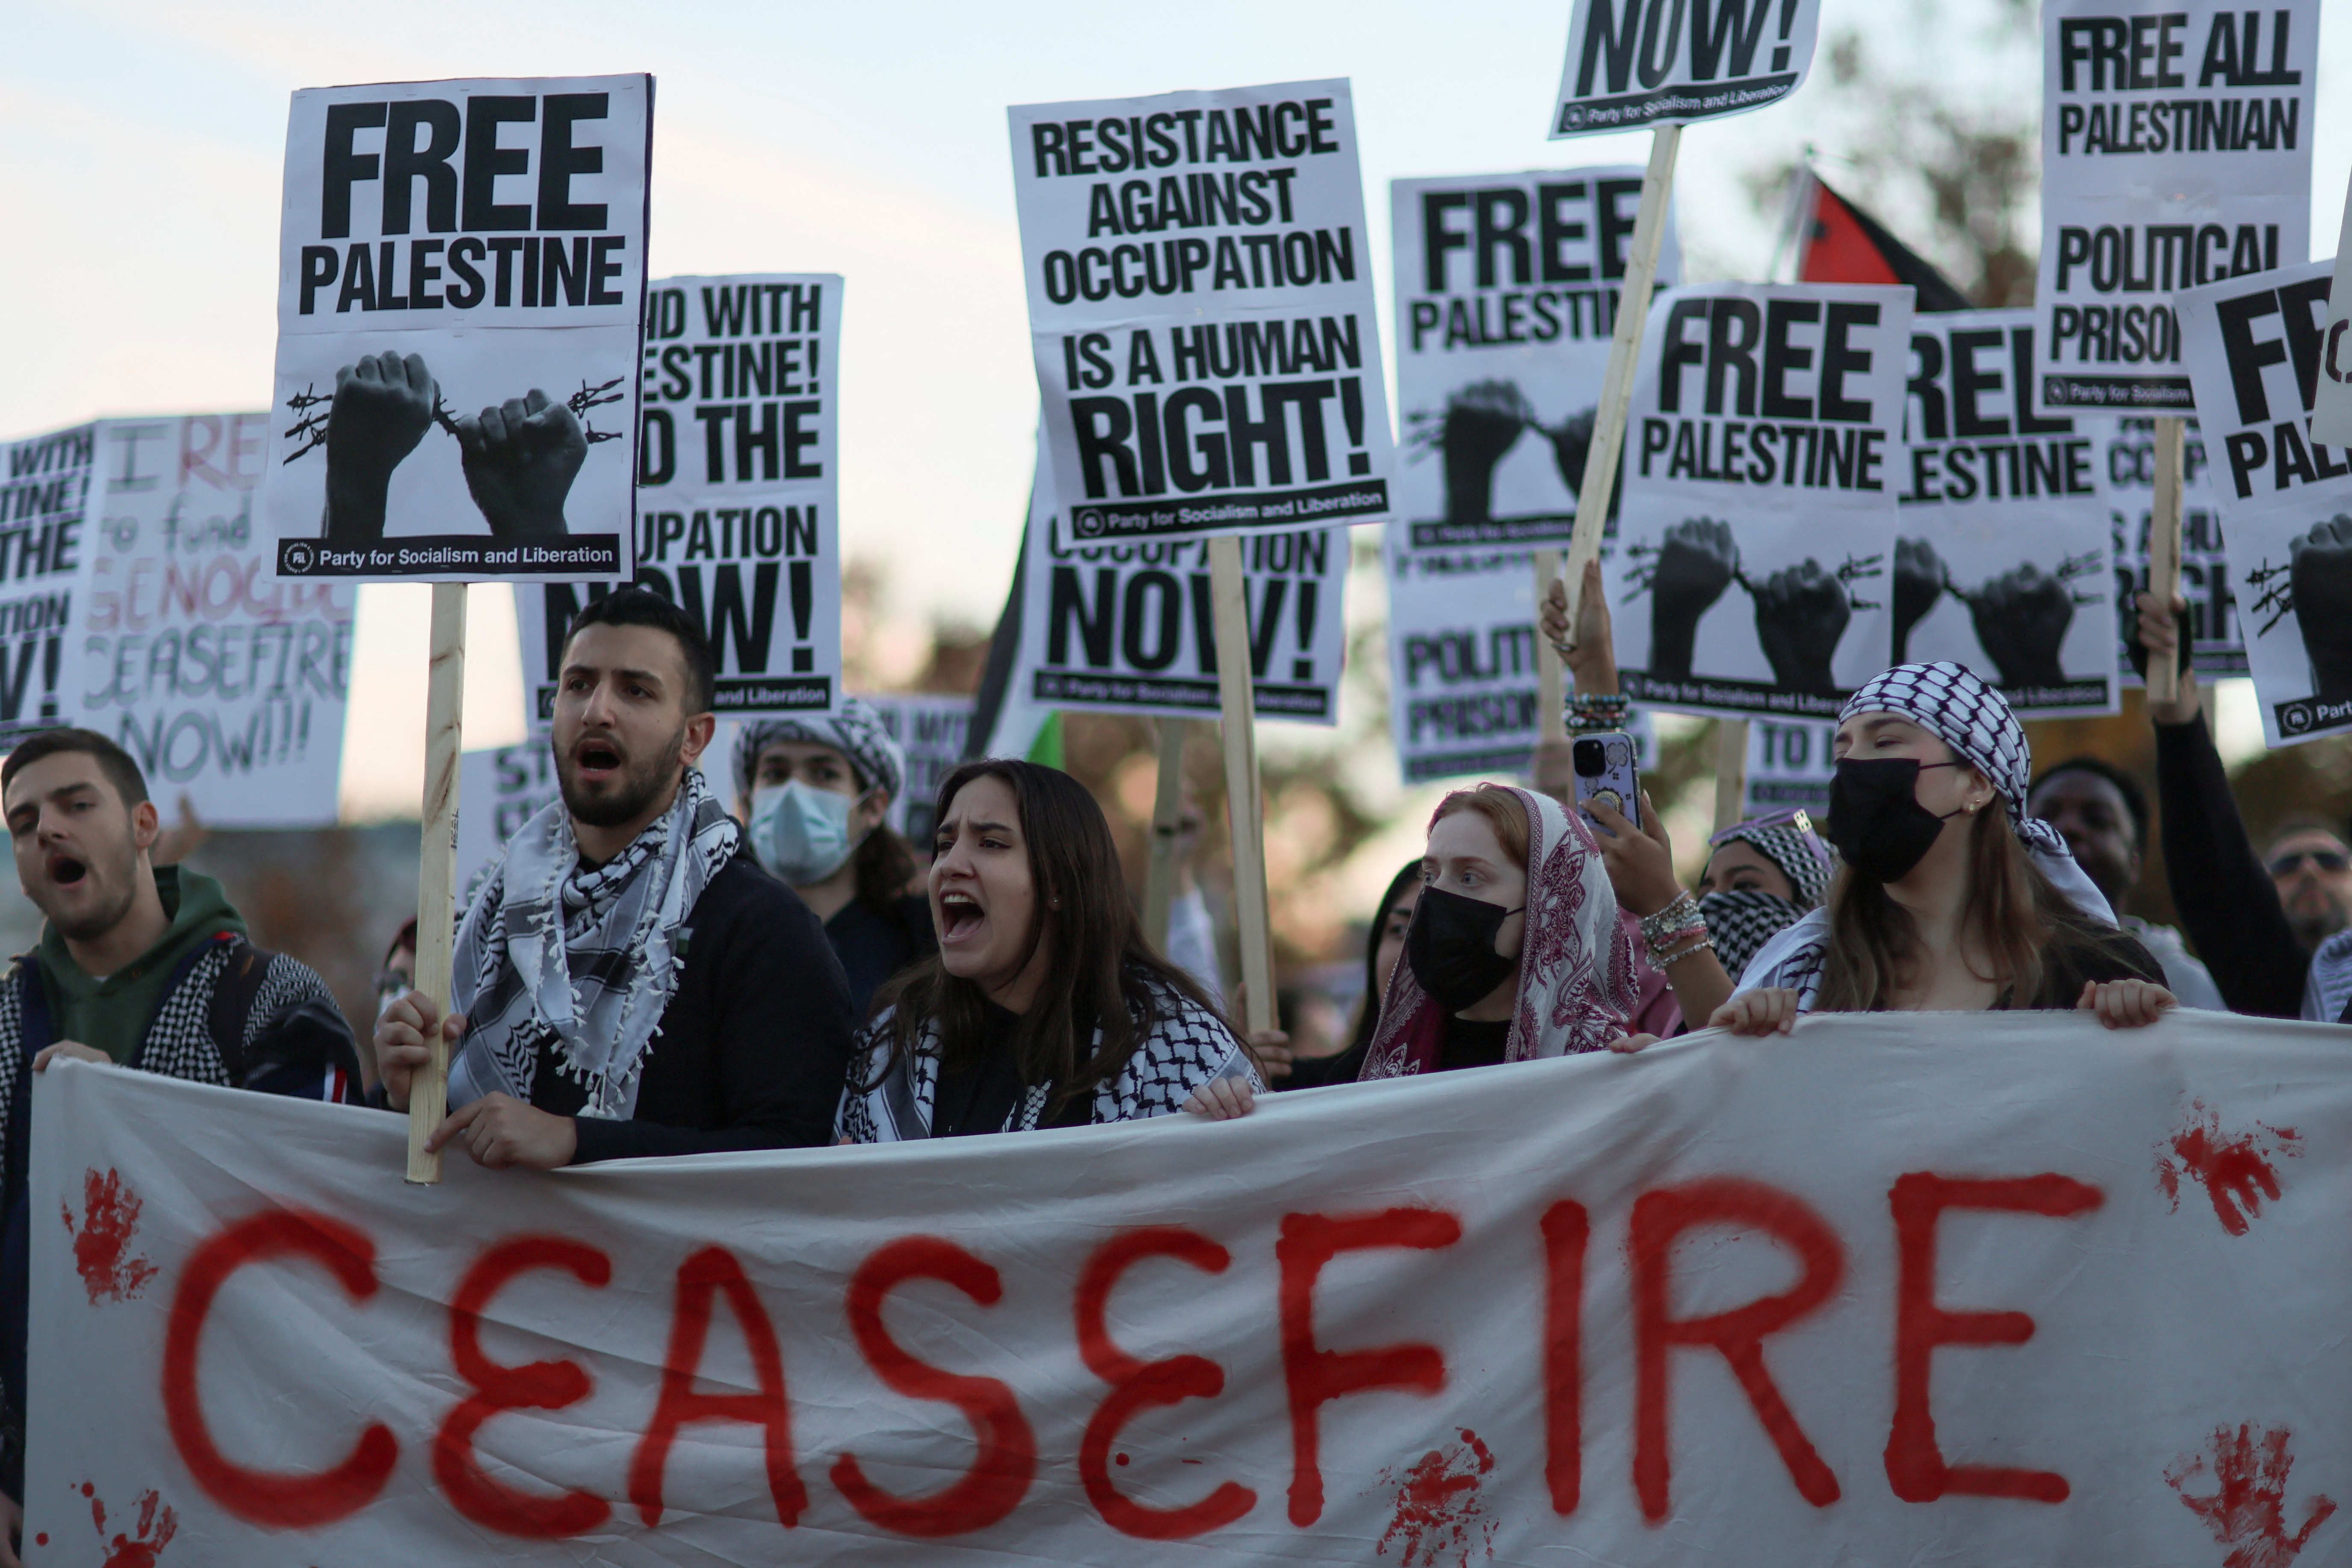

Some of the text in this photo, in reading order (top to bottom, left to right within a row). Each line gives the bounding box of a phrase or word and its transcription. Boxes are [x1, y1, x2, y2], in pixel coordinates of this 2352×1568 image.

[1574, 0, 1798, 97] NOW!
[2058, 9, 2302, 92] FREE ALL
[1031, 98, 1339, 177] RESISTANCE
[1587, 107, 1621, 123] Party
[1622, 105, 1643, 119] for
[1702, 92, 1727, 108] and
[1729, 84, 1789, 105] Liberation
[2059, 97, 2299, 155] PALESTINIAN
[322, 92, 609, 239] FREE
[1087, 168, 1297, 238] AGAINST
[1044, 228, 1357, 305] OCCUPATION
[1422, 179, 1645, 292] FREE
[299, 236, 625, 315] PALESTINE
[701, 283, 823, 338] WITH
[1062, 314, 1362, 390] IS A HUMAN
[1409, 281, 1669, 352] PALESTI
[1659, 298, 1881, 422] FREE
[2071, 384, 2106, 403] Party
[2109, 384, 2129, 402] for
[2131, 385, 2189, 402] Socialism
[11, 429, 94, 479] WITH
[107, 422, 169, 495] I
[694, 399, 823, 484] THE
[1070, 376, 1371, 499] RIGHT!
[1640, 417, 1885, 492] PALESTINE
[2225, 417, 2352, 500] PAL
[1108, 514, 1149, 530] Party
[1153, 512, 1175, 526] for
[1178, 505, 1258, 523] Socialism
[1262, 502, 1294, 518] and
[1297, 492, 1382, 515] Liberation
[319, 549, 365, 568] Party
[370, 549, 395, 565] for
[399, 547, 479, 565] Socialism
[485, 548, 518, 563] and
[522, 546, 613, 564] Liberation
[714, 687, 826, 703] and Liberation
[1644, 679, 1679, 701] Party
[1702, 685, 1766, 707] Socialism
[1767, 692, 1794, 710] and
[162, 1171, 2105, 1540] CEASEFIRE
